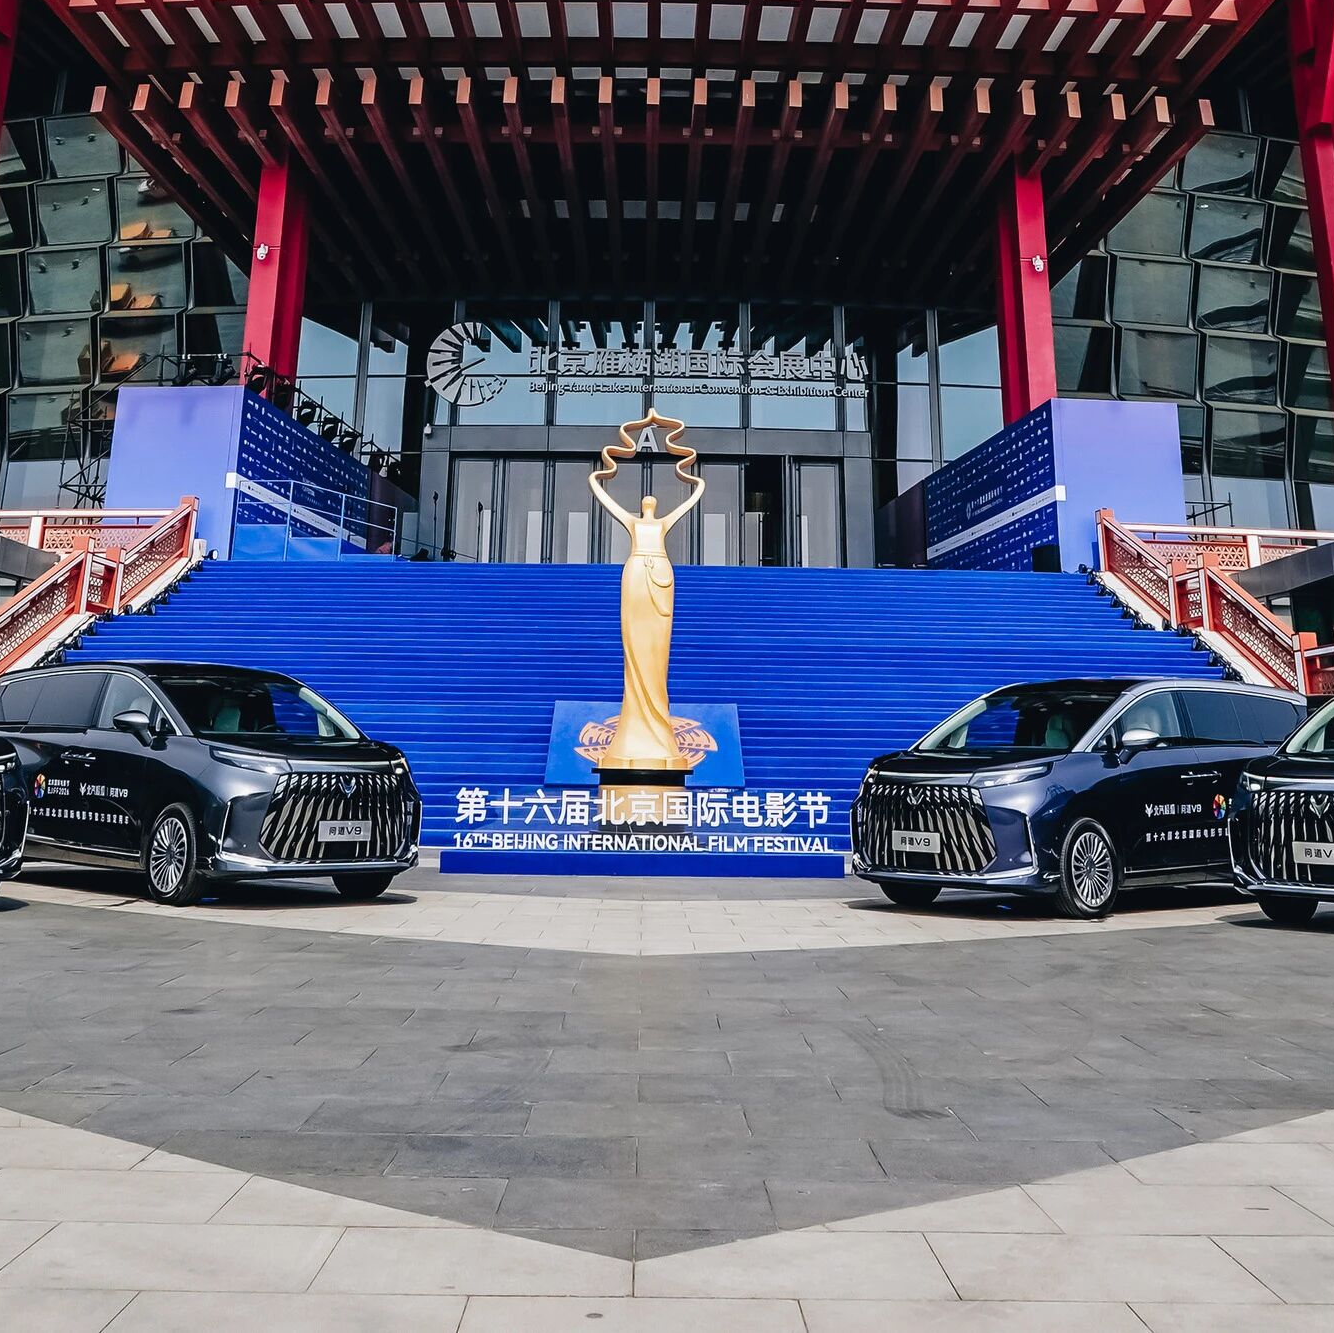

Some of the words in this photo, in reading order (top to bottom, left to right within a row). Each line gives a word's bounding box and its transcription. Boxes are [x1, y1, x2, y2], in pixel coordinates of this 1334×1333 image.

[530, 346, 868, 381] 北京雁栖湖国际会展中心
[529, 382, 564, 395] Beijing
[700, 383, 761, 395] Convention
[833, 386, 869, 398] Center
[636, 426, 659, 452] A
[454, 787, 832, 829] 第十六届北京国际电影节
[492, 833, 559, 851] BEIJING
[563, 834, 702, 853] INTERNATIONAL
[708, 835, 748, 853] FILM
[753, 836, 835, 854] FESTIVAL
